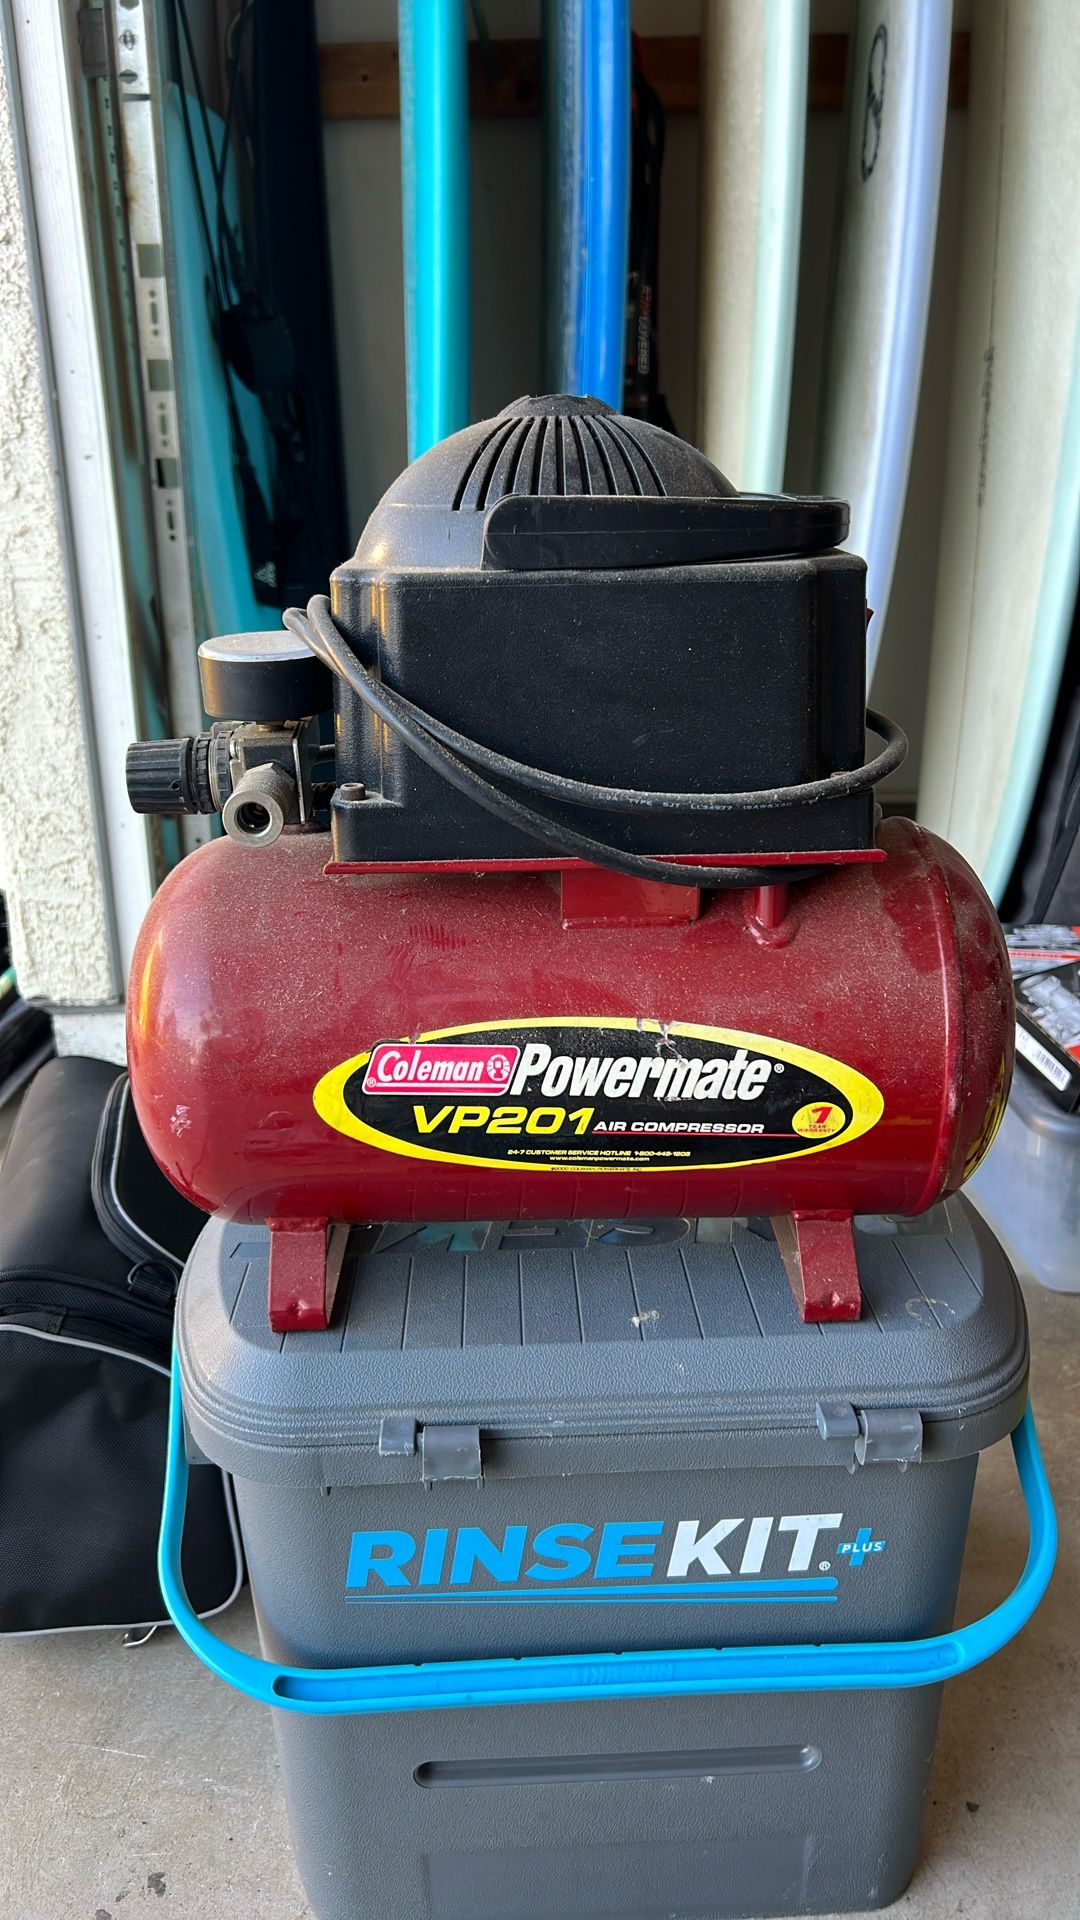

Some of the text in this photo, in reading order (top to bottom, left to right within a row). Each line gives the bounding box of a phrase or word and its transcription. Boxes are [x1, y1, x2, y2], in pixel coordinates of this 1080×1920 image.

[628, 797, 653, 806] TYPE
[376, 1048, 484, 1082] Coleman
[509, 1043, 773, 1101] Powermate
[412, 1105, 595, 1136] VP201
[811, 1106, 833, 1124] 1
[594, 1120, 764, 1135] AIR COMPRESSOR
[842, 1541, 882, 1554] PLUS
